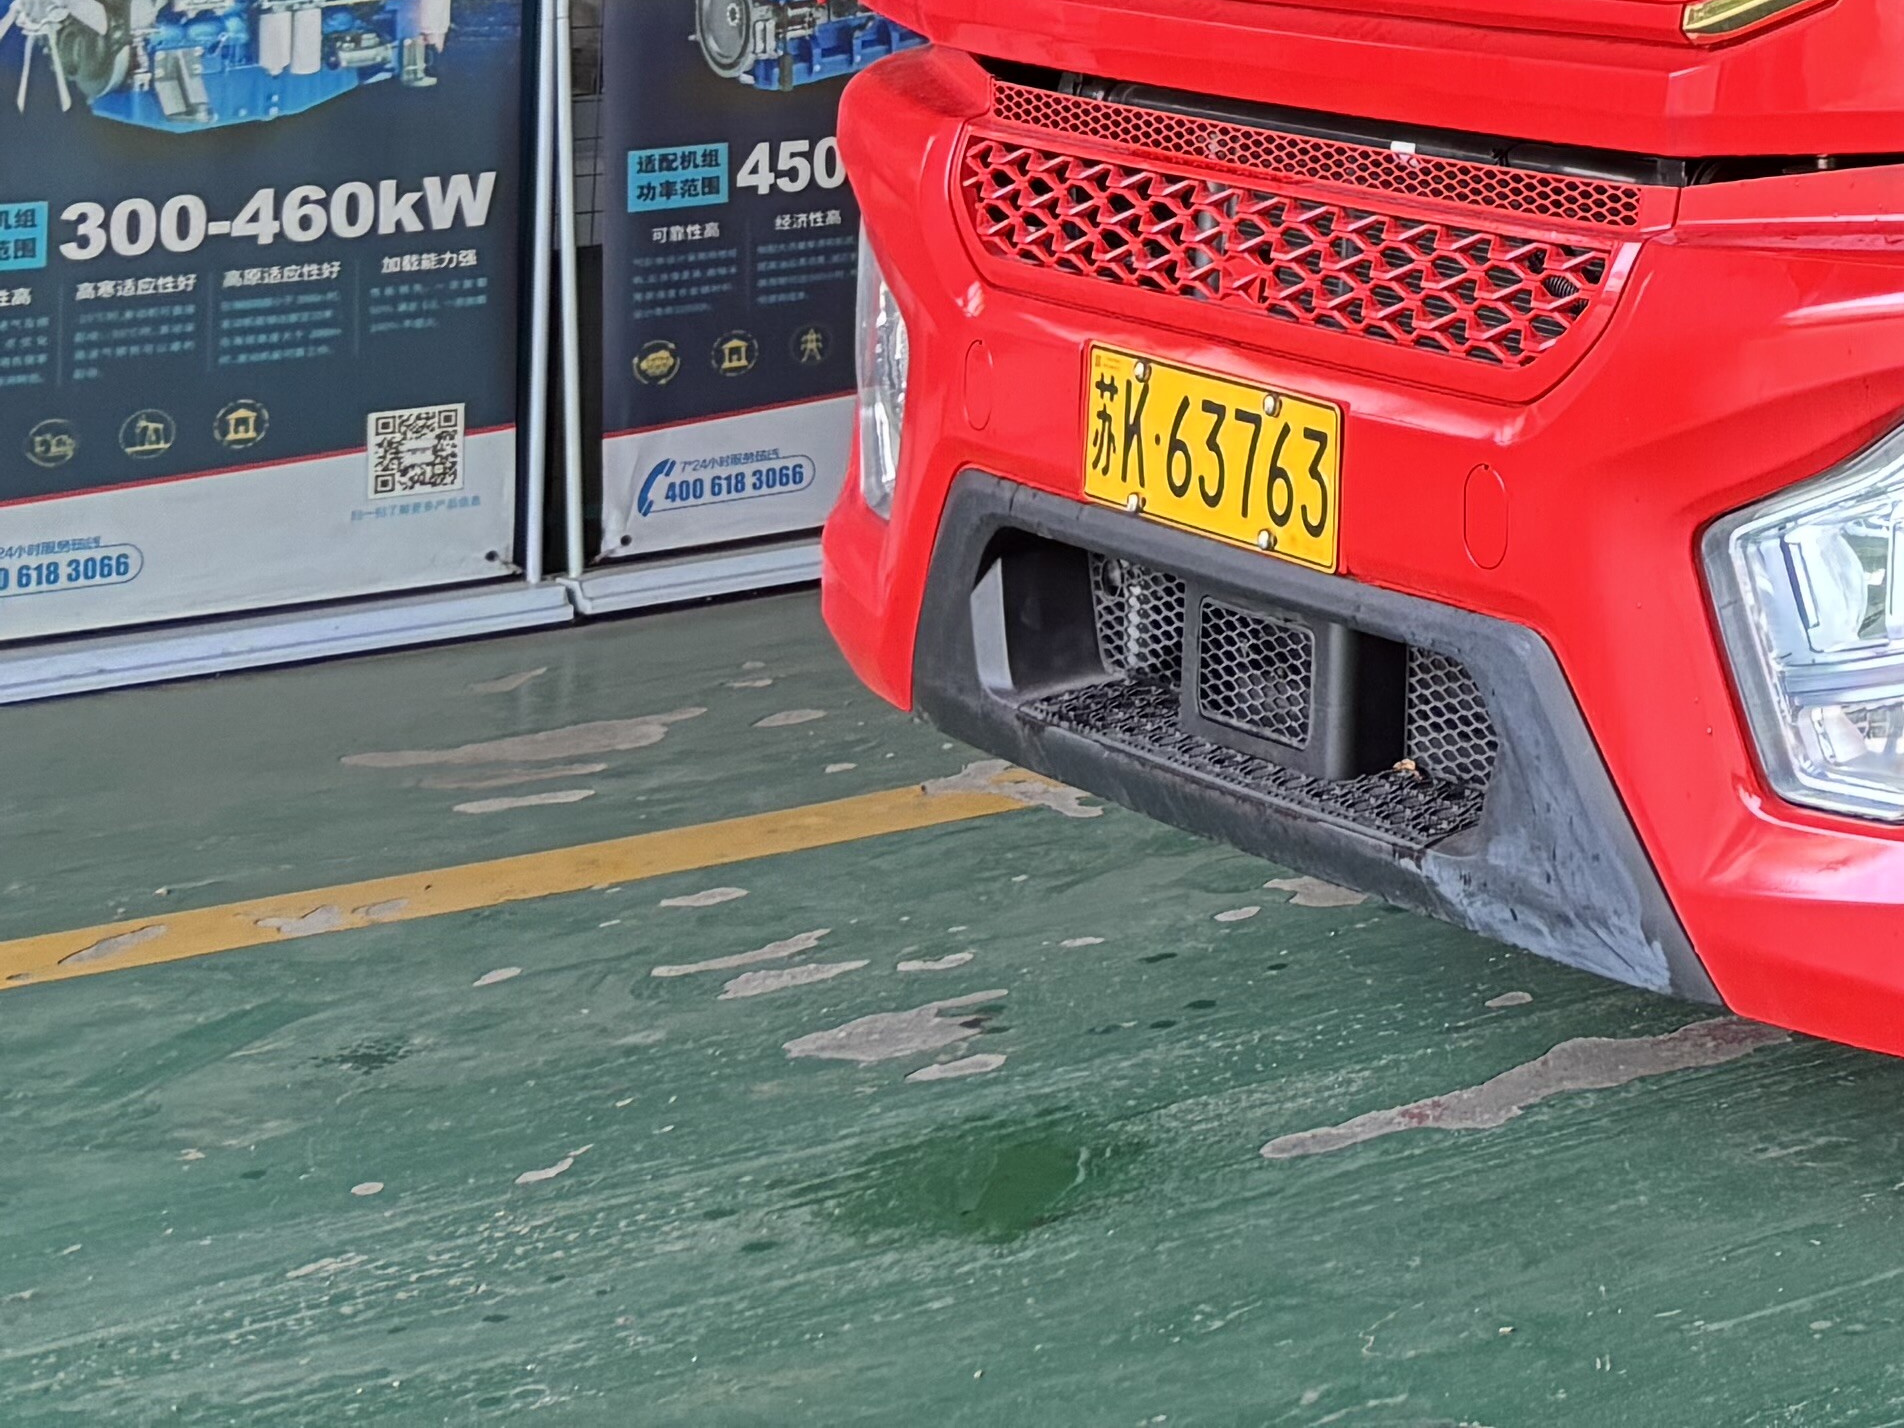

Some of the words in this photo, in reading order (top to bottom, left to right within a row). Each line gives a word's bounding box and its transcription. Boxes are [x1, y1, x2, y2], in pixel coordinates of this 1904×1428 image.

[636, 148, 721, 176] 适配机组
[636, 175, 721, 203] 功率范围
[58, 171, 498, 261] 300-460kW
[774, 210, 842, 231] 经济性高
[651, 222, 720, 243] 可靠性高
[221, 261, 342, 288] 高原适应性好
[380, 249, 478, 274] 加载能力强
[75, 274, 198, 301] 高寒适应性好
[664, 478, 704, 503] 400
[711, 472, 745, 497] 618
[752, 463, 804, 490] 3066
[17, 562, 60, 588] 618
[67, 553, 130, 583] 3066
